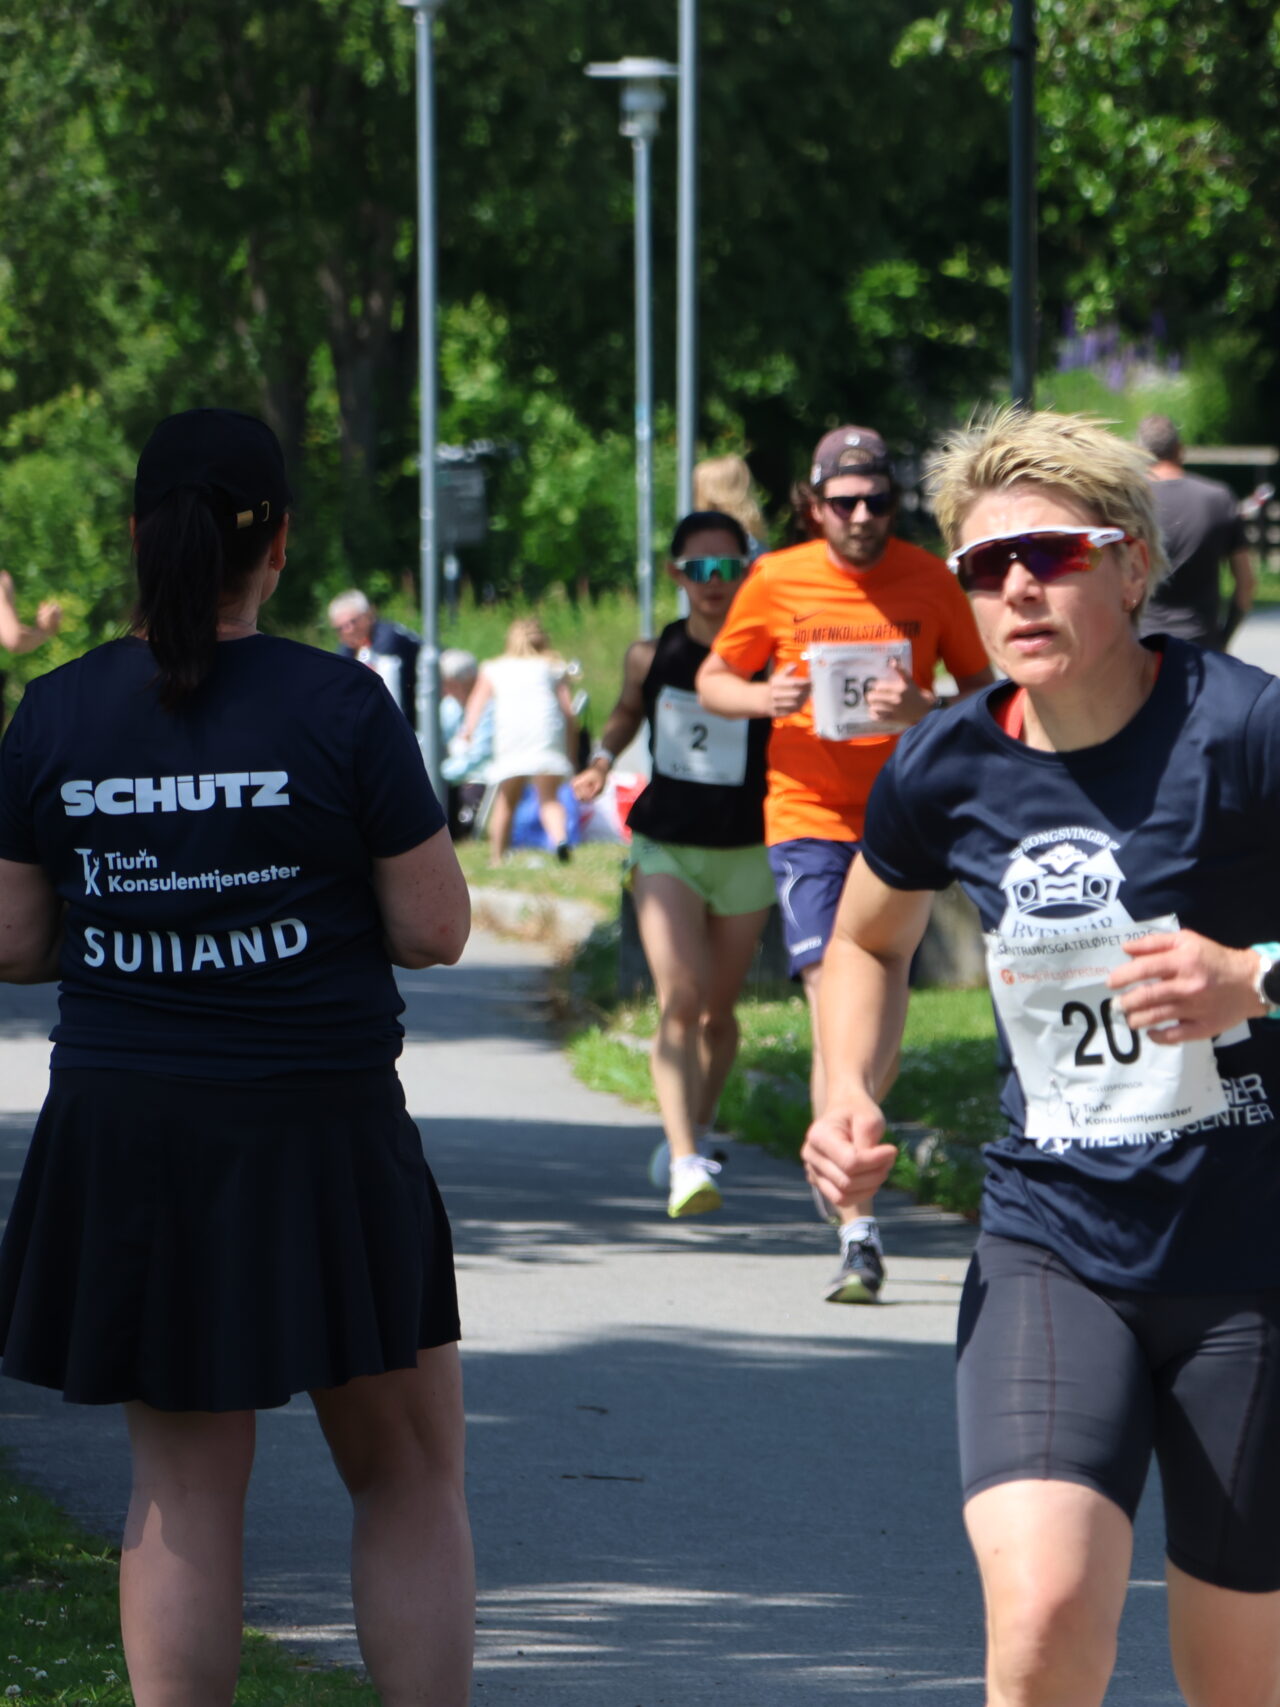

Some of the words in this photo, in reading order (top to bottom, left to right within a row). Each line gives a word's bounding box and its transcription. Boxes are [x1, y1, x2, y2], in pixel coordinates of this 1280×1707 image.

[691, 724, 708, 751] 2
[61, 771, 290, 816] SCHÜTZ
[107, 863, 300, 894] Konsulenttjenester
[1062, 998, 1141, 1066] 20
